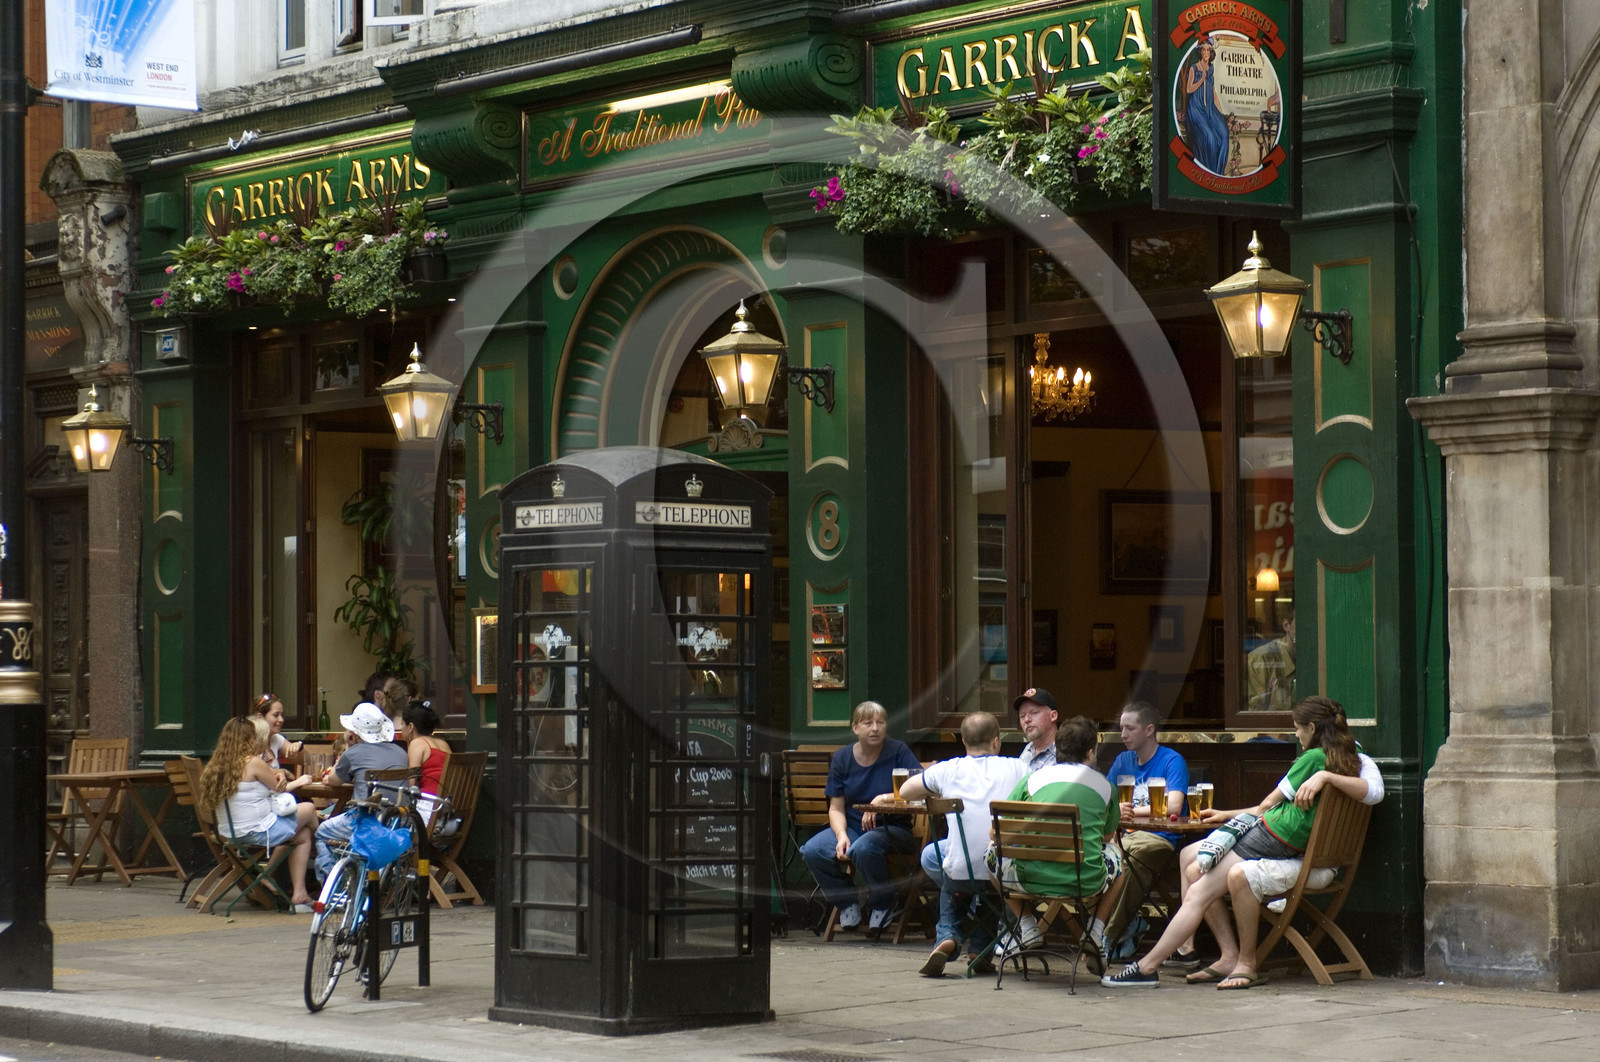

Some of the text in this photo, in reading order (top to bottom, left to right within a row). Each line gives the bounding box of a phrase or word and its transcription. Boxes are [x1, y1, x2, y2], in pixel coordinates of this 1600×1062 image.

[1186, 2, 1272, 33] GARRICK ARMS
[146, 62, 179, 72] WEST END
[896, 18, 1100, 99] GARRICK
[1221, 51, 1255, 65] GARRICK
[54, 69, 134, 87] City of Westminster
[146, 72, 173, 81] LONDON
[1226, 65, 1263, 79] THEATRE
[1220, 84, 1267, 97] PHILADELPHIA
[580, 96, 710, 158] Traditional
[206, 152, 431, 227] GARRICK ARMS
[1206, 176, 1246, 191] Traditional
[26, 306, 61, 321] GARRICK
[26, 326, 71, 341] MANSIONS
[536, 506, 603, 525] TELEPHONE
[662, 506, 750, 525] TELEPHONE
[818, 500, 841, 551] 8
[697, 718, 735, 738] ARMS
[690, 767, 709, 788] Cup
